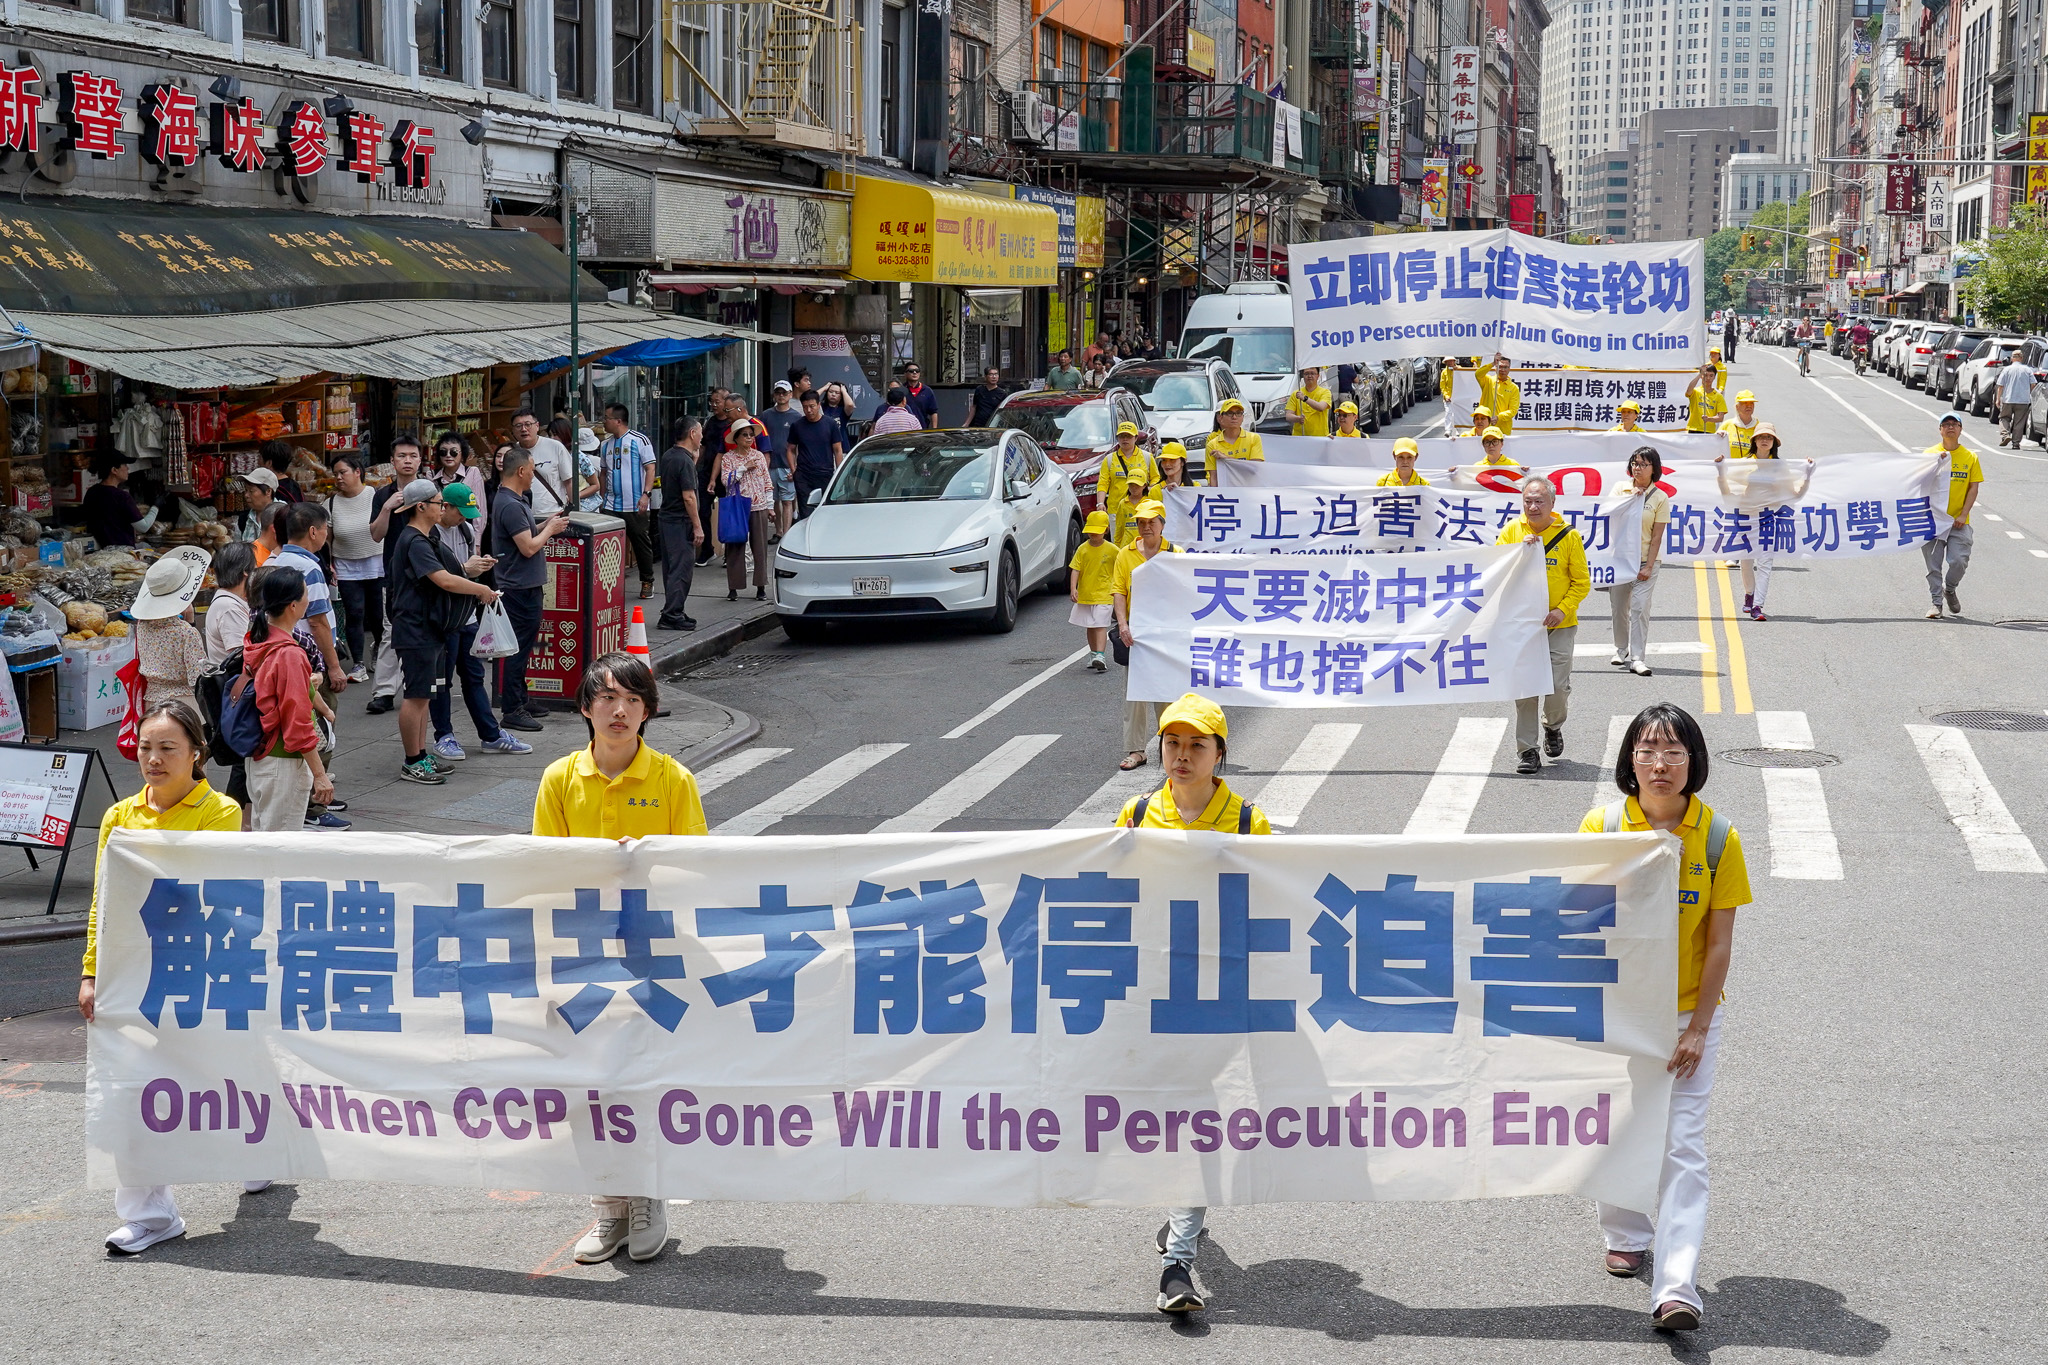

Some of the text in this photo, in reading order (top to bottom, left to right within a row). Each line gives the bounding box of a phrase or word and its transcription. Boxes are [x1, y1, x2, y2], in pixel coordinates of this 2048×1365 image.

[1930, 180, 1944, 228] 大帝國
[875, 241, 932, 254] 福州小吃店
[878, 255, 929, 265] 646-326-8810
[1303, 245, 1690, 315] 立即停止迫害法轮功
[1311, 319, 1689, 353] Stop Persecution of Falun Gong in China
[1513, 402, 1690, 425] 虛假輿論抹法輪功
[1666, 496, 1938, 555] 的法輪功學員
[871, 581, 887, 591] 2673
[1588, 561, 1615, 584] ina
[1190, 563, 1484, 624] 天要滅中共
[596, 610, 613, 627] SHOW
[596, 625, 621, 658] LOVE
[1189, 634, 1489, 696] 誰也擋不住
[1, 790, 44, 801] Open house
[1689, 862, 1704, 876] 法
[139, 871, 1618, 1043] 解體中共才能停止迫害
[140, 1077, 1611, 1154] Only When CCP is Gone Will the Persecution End
